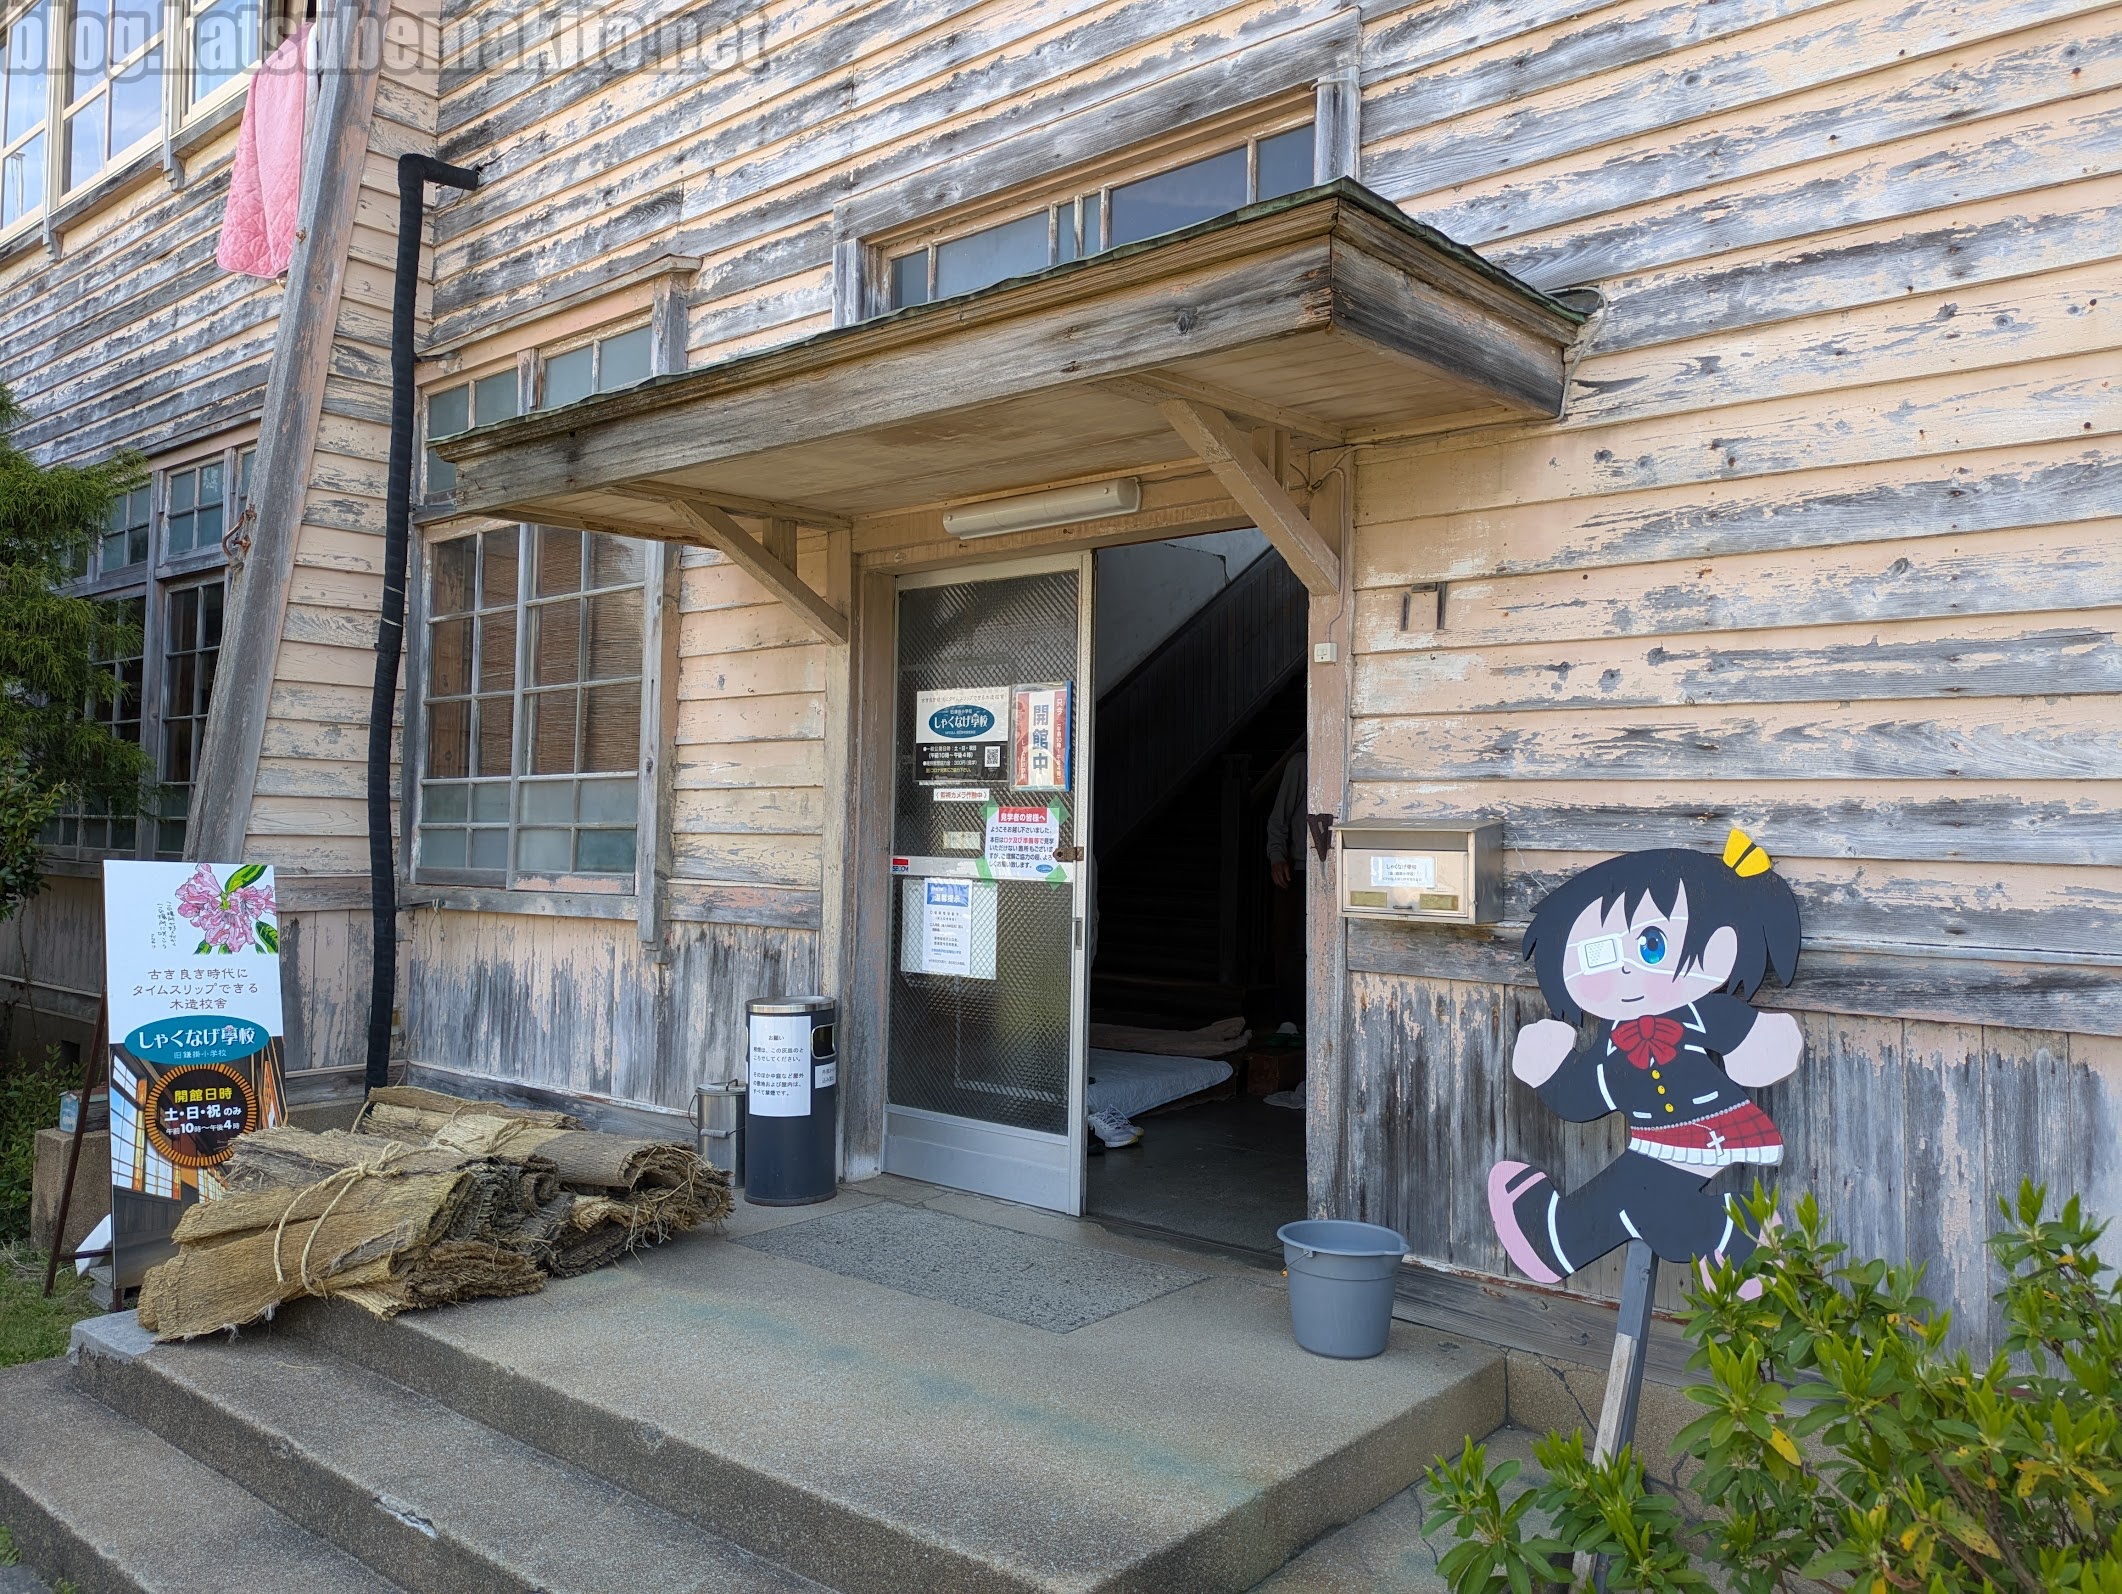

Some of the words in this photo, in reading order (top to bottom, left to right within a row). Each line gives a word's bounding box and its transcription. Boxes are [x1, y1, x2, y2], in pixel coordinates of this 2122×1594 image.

[1056, 698, 1063, 716] 只今
[1033, 704, 1049, 776] 開館中
[1000, 812, 1046, 822] 見学者の皆様へ
[990, 826, 1053, 834] ようこそお越し下さいました。
[989, 836, 1055, 845] 本日はロケ及び準備等で見学
[989, 845, 1054, 853] いただけない箇所もございま
[148, 967, 248, 980] 古き良き時代に
[132, 983, 258, 996] タイムスリップできる
[169, 997, 228, 1010] 木造校舎
[173, 1049, 227, 1059] 旧鎌掛小学校
[753, 1055, 802, 1063] ころでしてください。
[753, 1072, 805, 1080] そのほか中庭など屋外
[174, 1087, 232, 1103] 開館日時
